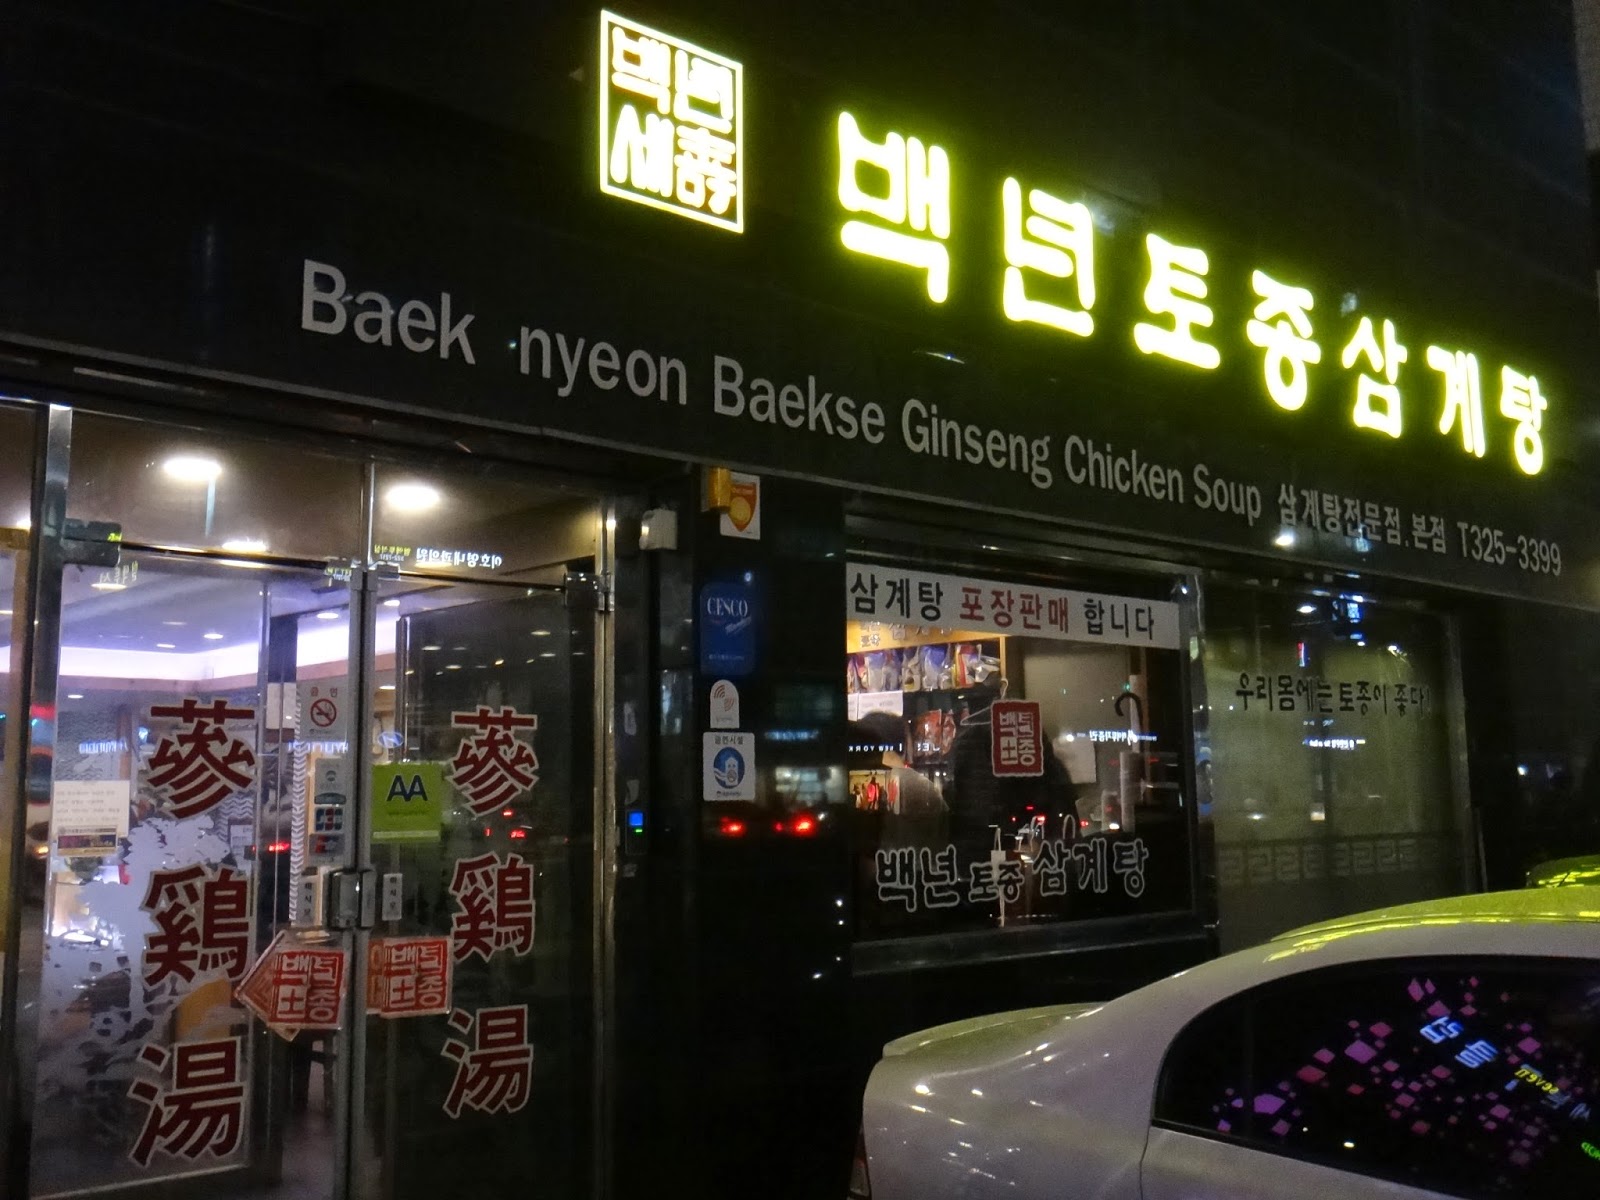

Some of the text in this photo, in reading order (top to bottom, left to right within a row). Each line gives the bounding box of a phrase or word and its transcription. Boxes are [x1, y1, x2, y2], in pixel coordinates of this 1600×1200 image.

[301, 258, 476, 365] Baek
[518, 324, 688, 405] nyeon
[713, 355, 886, 444] Baekse
[901, 398, 1053, 492] Ginseng
[1064, 434, 1184, 504] Chicken
[1193, 464, 1262, 527] Soup
[1457, 521, 1562, 577] T325-3399
[706, 597, 748, 617] CESCO
[850, 572, 944, 621] 삼계탕
[959, 586, 1069, 634] 포장판매
[1083, 598, 1155, 640] 합니다
[386, 774, 429, 802] AA
[875, 837, 1150, 913] 백년 토종 삼계탕
